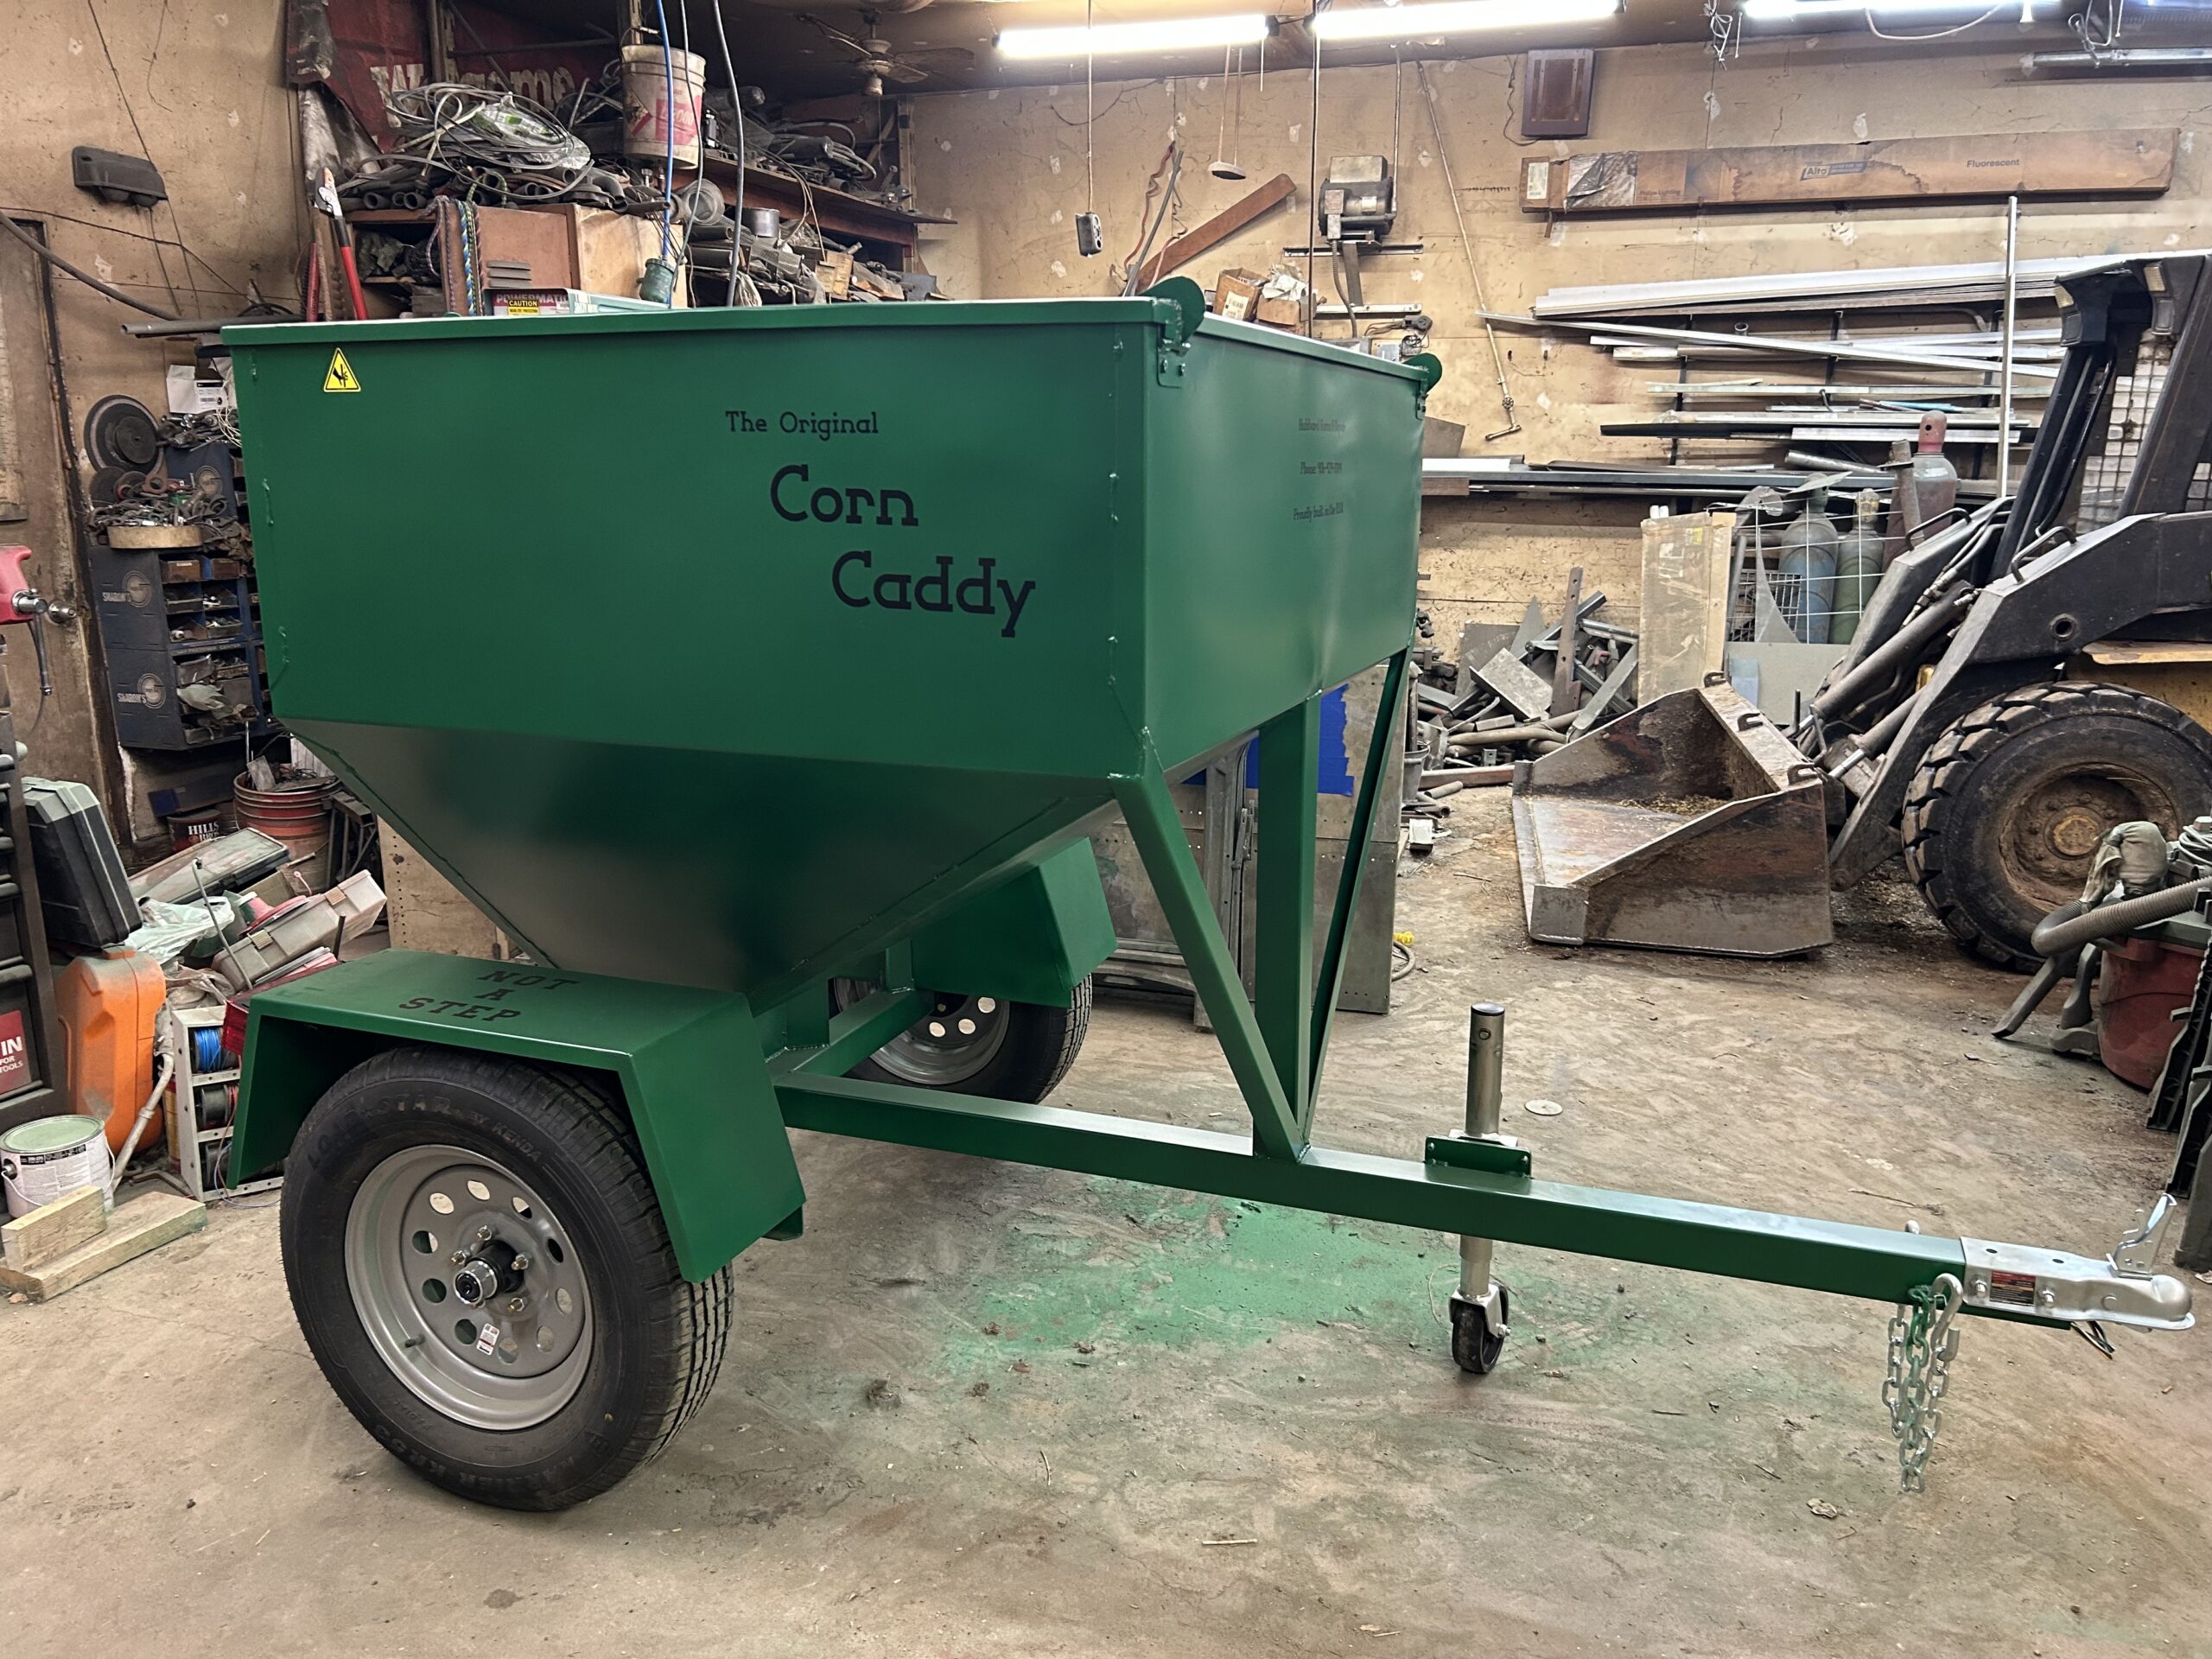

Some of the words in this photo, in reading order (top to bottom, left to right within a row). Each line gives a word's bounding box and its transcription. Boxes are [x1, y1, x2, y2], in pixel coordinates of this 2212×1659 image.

[1966, 158, 2020, 168] Fluorescent
[725, 410, 767, 433] The
[779, 411, 880, 442] Original
[770, 463, 919, 526] Corn
[831, 550, 1037, 639] Caddy
[188, 821, 219, 836] HILLS
[476, 969, 581, 991] NOT
[473, 988, 516, 1001] A
[398, 996, 522, 1022] STEP
[492, 1121, 543, 1163] KENDA
